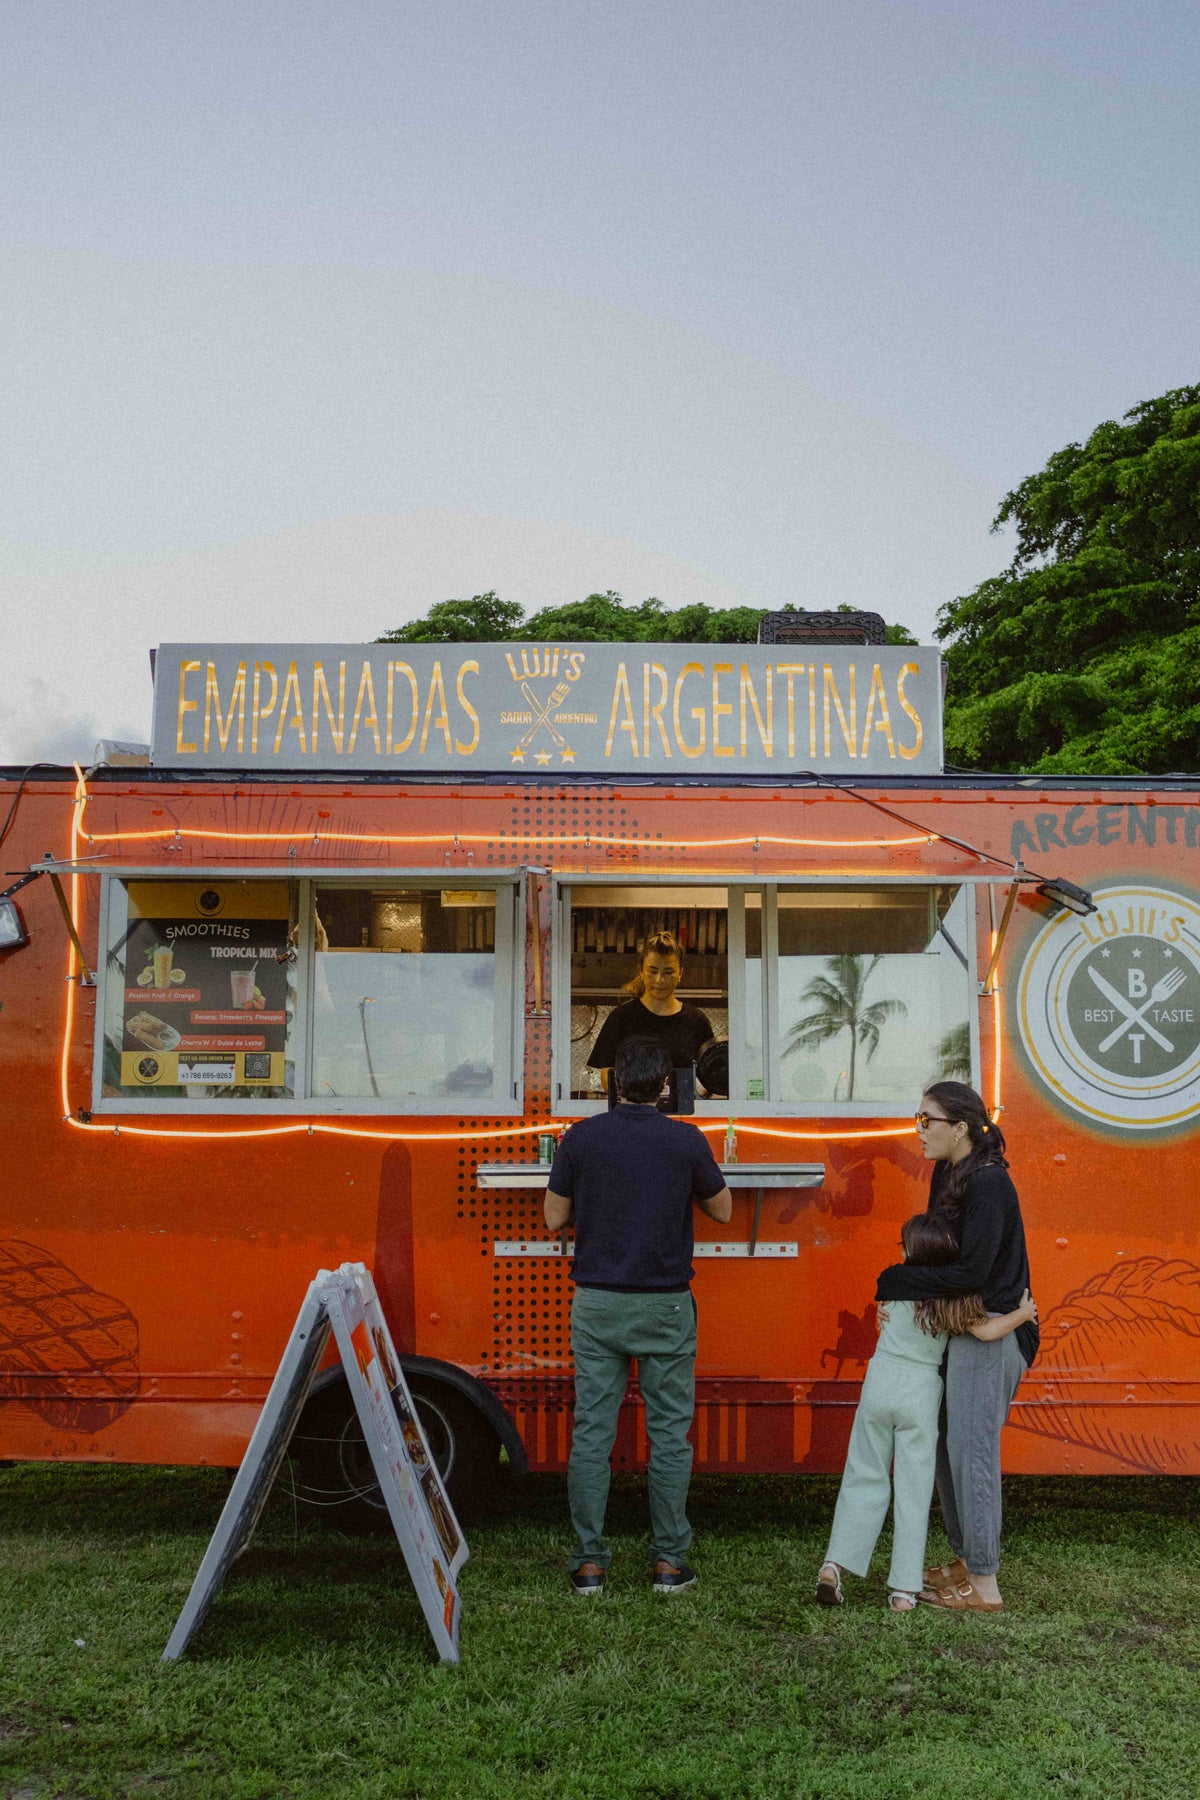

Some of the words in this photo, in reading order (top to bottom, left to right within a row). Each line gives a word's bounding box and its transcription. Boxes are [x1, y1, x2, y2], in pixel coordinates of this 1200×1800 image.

[176, 660, 480, 756] EMPANADAS
[604, 662, 923, 760] ARGENTINAS
[501, 711, 532, 724] SABOR
[554, 712, 598, 724] ARGENTINO
[1010, 802, 1200, 860] ARGENTI
[166, 924, 251, 939] SMOOTHIES
[210, 947, 257, 958] TROPICAL
[259, 948, 278, 958] MIX
[1128, 968, 1148, 998] B
[173, 993, 195, 1001] Orange
[1084, 1009, 1115, 1022] BEST
[1153, 1009, 1194, 1022] TASTE
[1128, 1034, 1145, 1063] T
